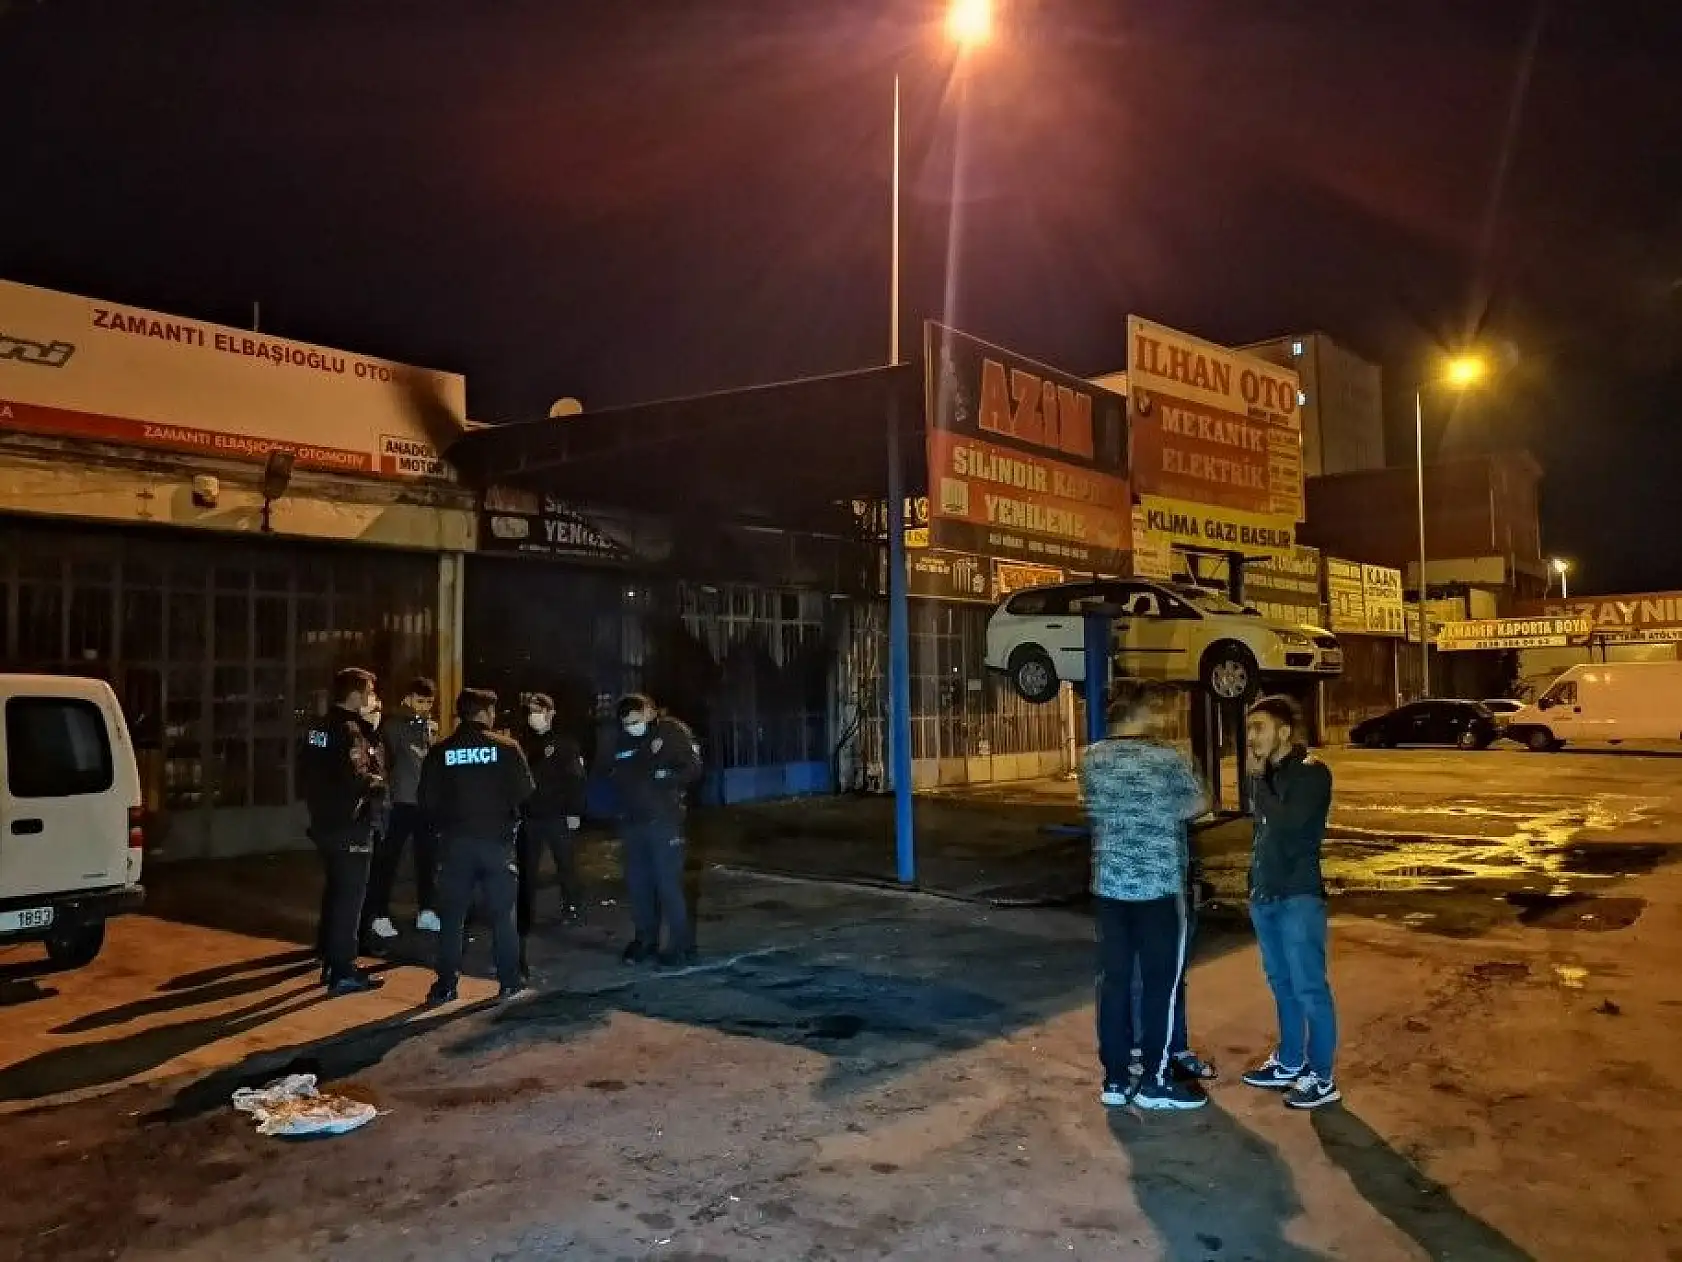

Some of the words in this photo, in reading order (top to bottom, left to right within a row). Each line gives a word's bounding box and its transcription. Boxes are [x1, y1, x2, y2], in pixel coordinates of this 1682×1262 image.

[94, 308, 205, 347] ZAMANTI
[214, 333, 346, 375] ELBAŞIOĞLU
[354, 362, 398, 382] OTO
[1240, 369, 1295, 414] OTO
[144, 424, 212, 445] ZAMANTI
[385, 439, 436, 458] ANADO
[953, 444, 1048, 492] SİLİNDİR
[1161, 448, 1265, 490] ELEKTRİK
[1497, 621, 1552, 637] KAPORTA
[1555, 618, 1589, 635] BOYA
